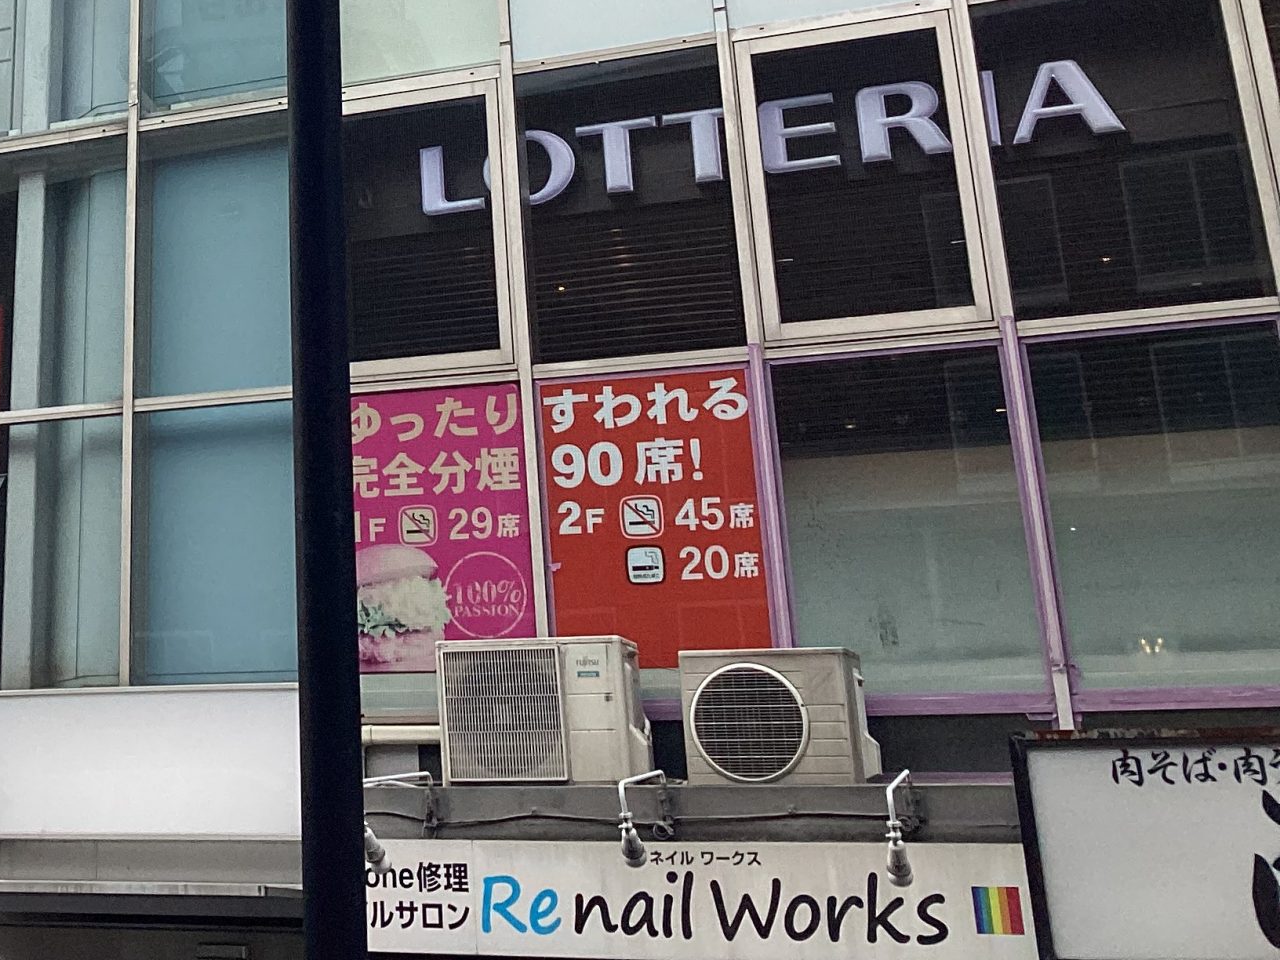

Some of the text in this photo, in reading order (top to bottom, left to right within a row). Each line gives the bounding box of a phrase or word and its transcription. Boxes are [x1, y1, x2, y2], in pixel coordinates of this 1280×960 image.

[419, 59, 1127, 216] LOTTERIA
[351, 393, 519, 445] ゆったり
[543, 377, 749, 434] すわれる
[352, 446, 521, 499] 完全分煙
[557, 501, 605, 535] 2F
[453, 579, 522, 604] 100%
[454, 604, 520, 618] PASSION
[1112, 747, 1280, 787] 肉そば・肉
[650, 851, 762, 867] ネイル ワークス
[710, 871, 949, 945] Works
